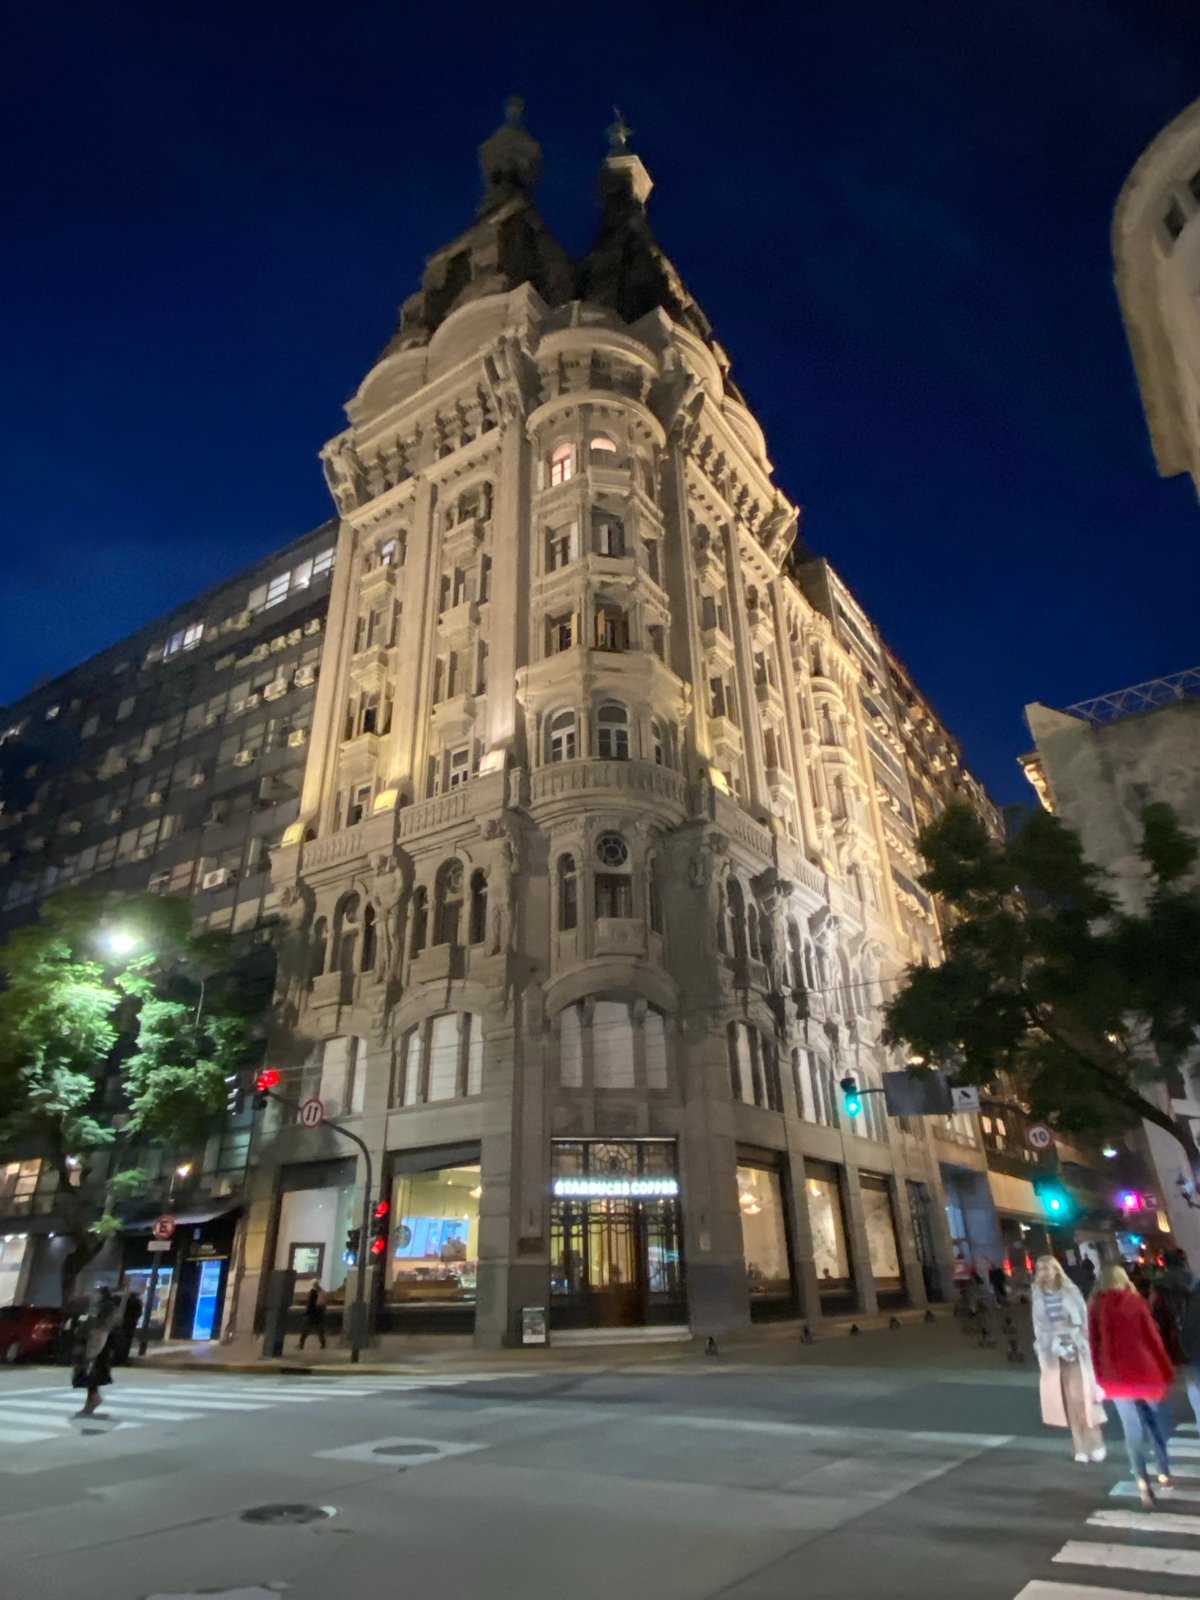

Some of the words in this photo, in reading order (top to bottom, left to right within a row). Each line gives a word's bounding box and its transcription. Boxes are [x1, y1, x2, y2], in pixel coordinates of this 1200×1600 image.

[1032, 1131, 1047, 1144] 10
[554, 1181, 630, 1195] STARBUCKS
[631, 1181, 679, 1195] COFFEE
